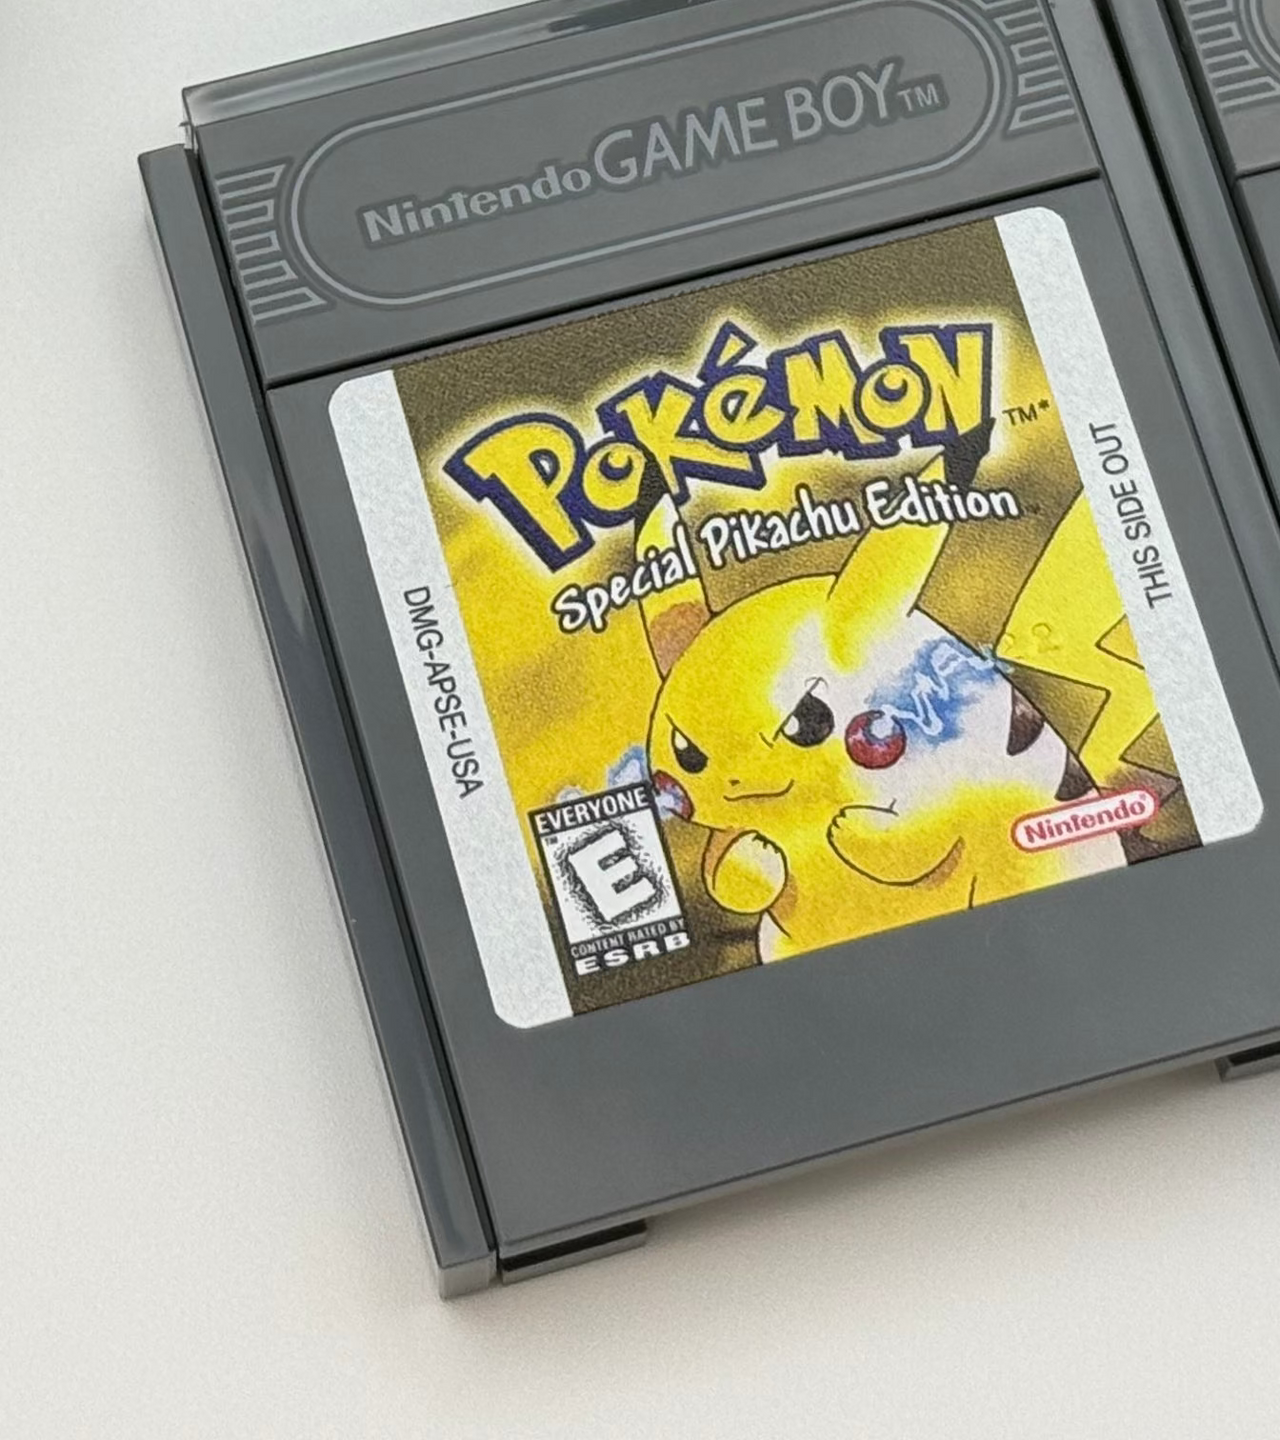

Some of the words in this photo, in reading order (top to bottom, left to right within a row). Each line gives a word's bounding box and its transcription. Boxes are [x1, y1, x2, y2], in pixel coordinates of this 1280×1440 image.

[362, 164, 591, 243] Nintendo
[593, 96, 780, 186] GAME
[1088, 422, 1130, 476] OUT
[1109, 479, 1151, 543] SIDE
[554, 522, 694, 633] Special
[868, 477, 1019, 535] Edition
[1132, 544, 1173, 611] THIS
[404, 586, 484, 799] DMG-APSE-USA
[534, 786, 649, 834] EVERYONE
[1024, 799, 1146, 844] Nintendo
[568, 829, 657, 923] E
[571, 934, 625, 958] CONTENT
[627, 924, 667, 943] RATED
[575, 931, 691, 976] ESRB
